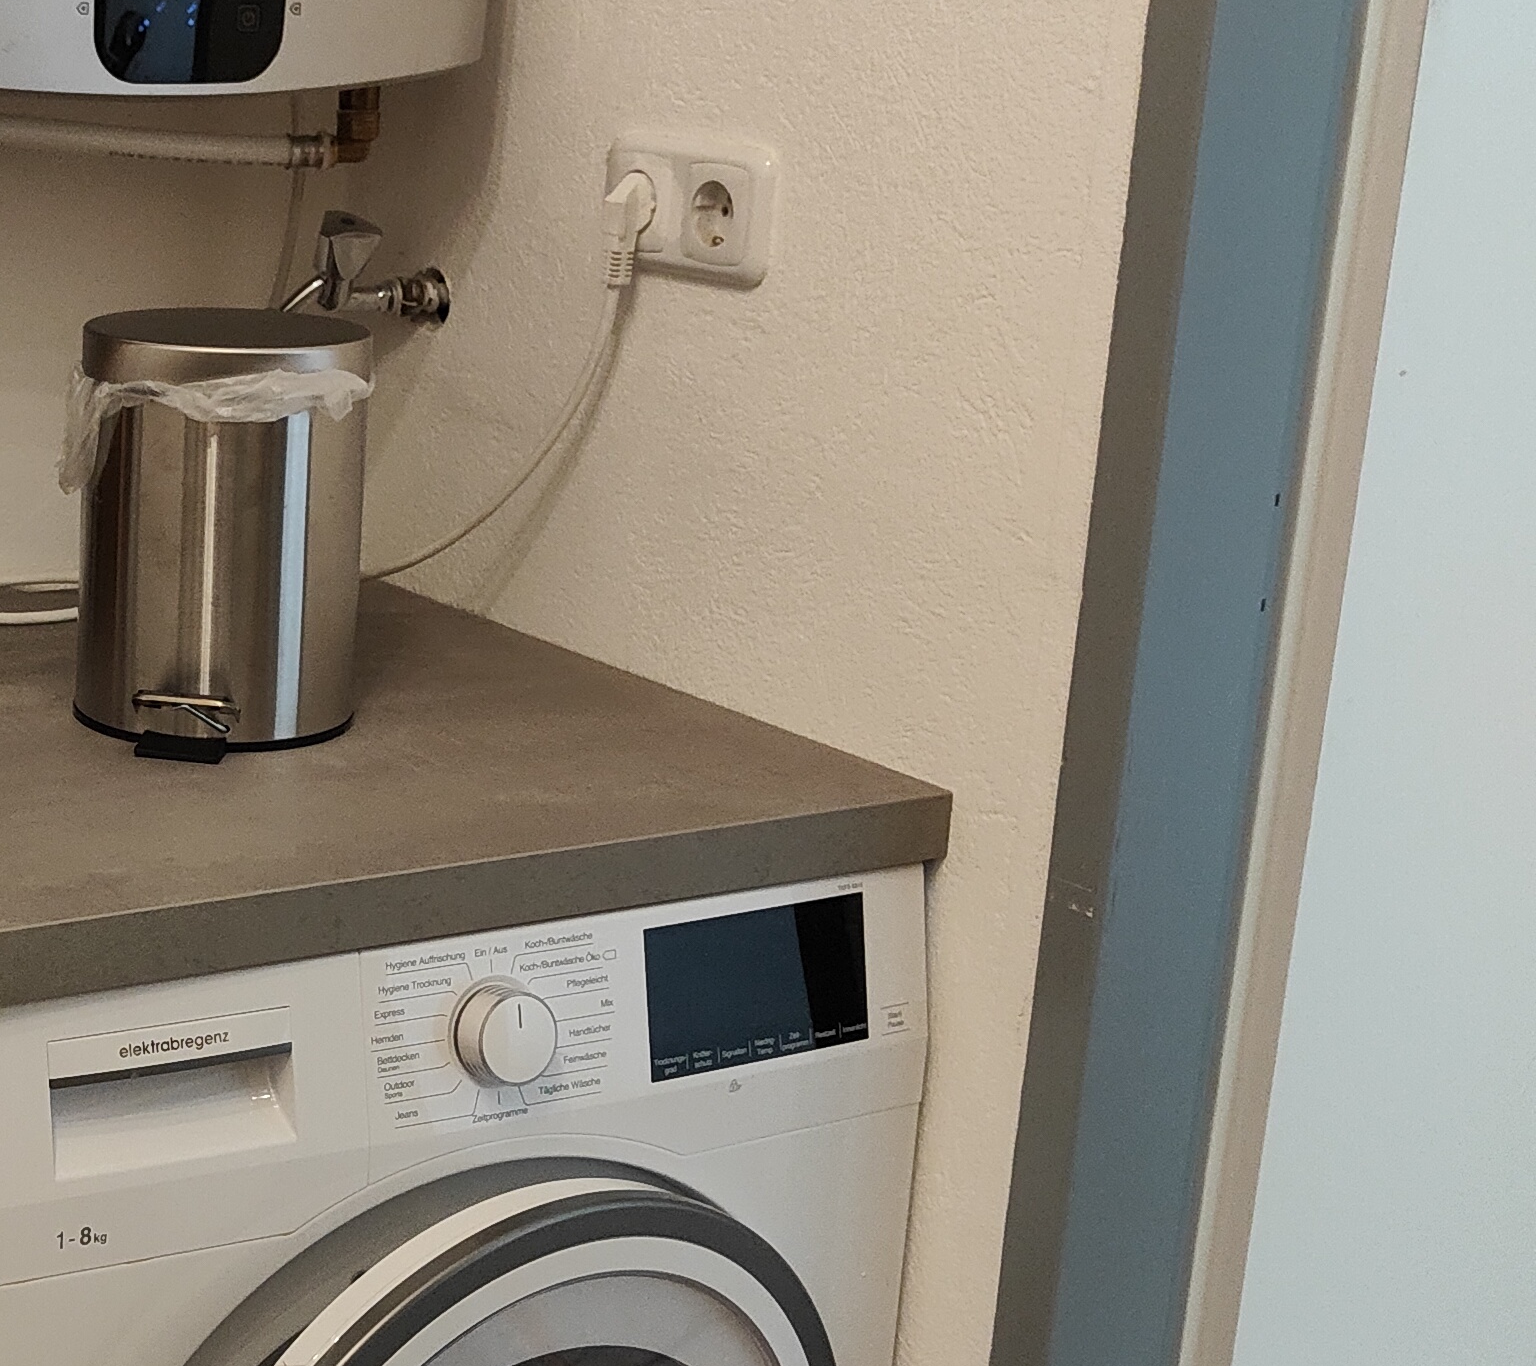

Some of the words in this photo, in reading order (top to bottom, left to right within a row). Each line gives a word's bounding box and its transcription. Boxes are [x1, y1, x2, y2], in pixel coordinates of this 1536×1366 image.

[474, 948, 486, 957] Ein
[492, 945, 508, 955] Aus
[385, 959, 417, 971] Hygiene
[378, 983, 409, 996] Hygiene
[411, 977, 452, 990] Trocknung
[374, 1007, 405, 1020] Express
[118, 1030, 230, 1059] elektrabregenz
[371, 1033, 404, 1045] Hemden
[377, 1052, 420, 1066] Bettdecken
[384, 1079, 415, 1092] Outdoor
[571, 1078, 601, 1089] Wäsche
[395, 1109, 419, 1120] Jeans
[472, 1107, 529, 1124] Zeitprogramme
